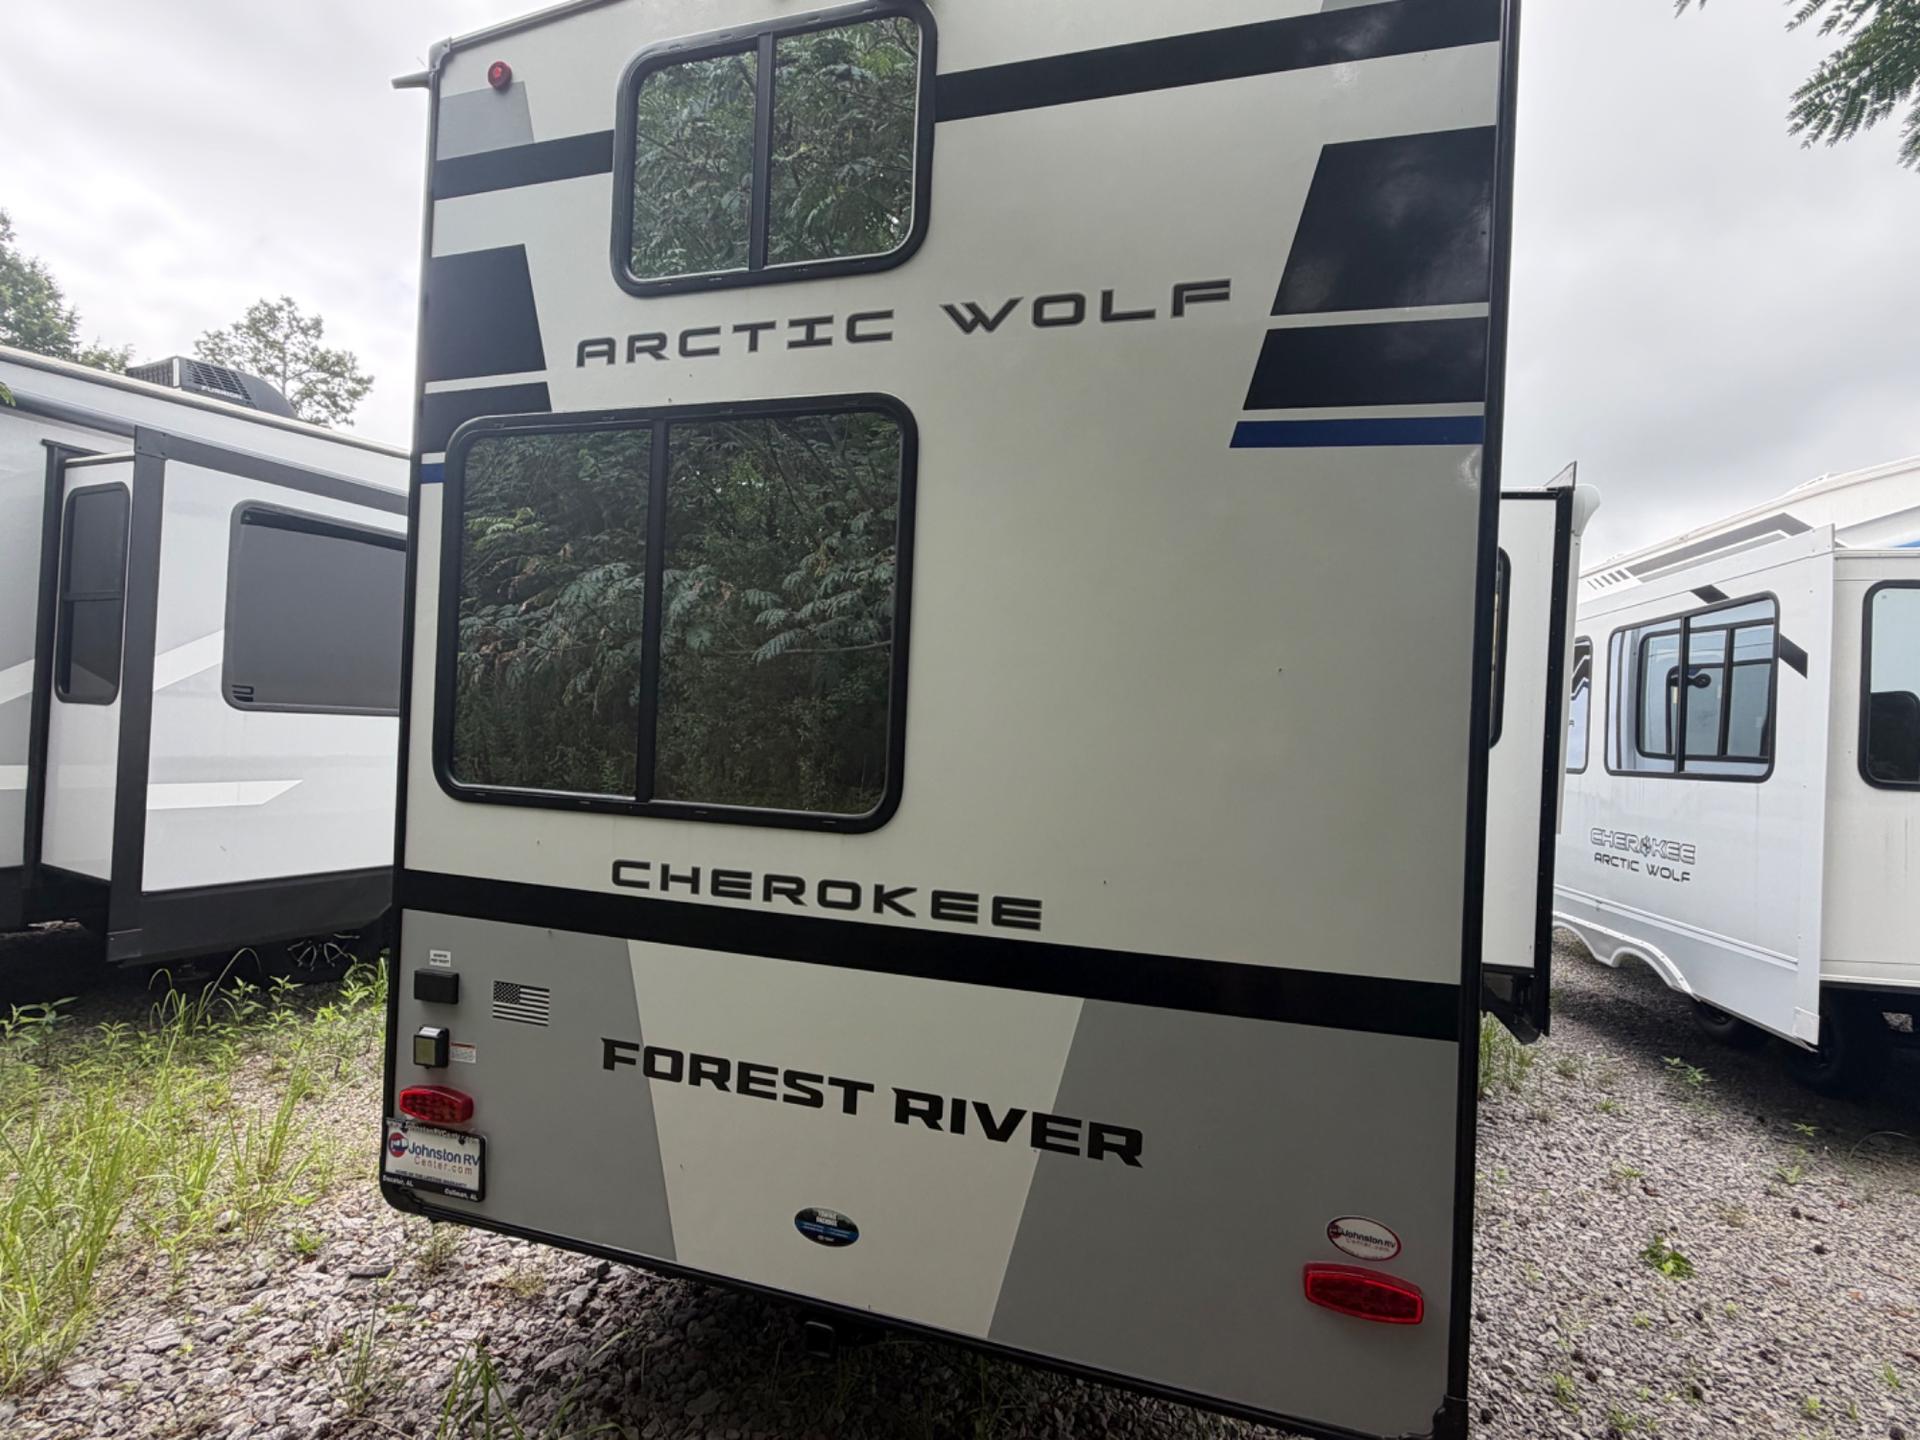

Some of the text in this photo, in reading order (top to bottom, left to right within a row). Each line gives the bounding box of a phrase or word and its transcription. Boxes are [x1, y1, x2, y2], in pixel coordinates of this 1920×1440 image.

[575, 278, 1232, 368] ARCTIC WOLF
[1594, 852, 1691, 882] ARCTIC WOLF
[611, 858, 1043, 932] CHEROKEE
[600, 1037, 1144, 1168] FOREST RIVER
[408, 1142, 480, 1166] Johnston RV
[414, 1156, 473, 1175] Center.com
